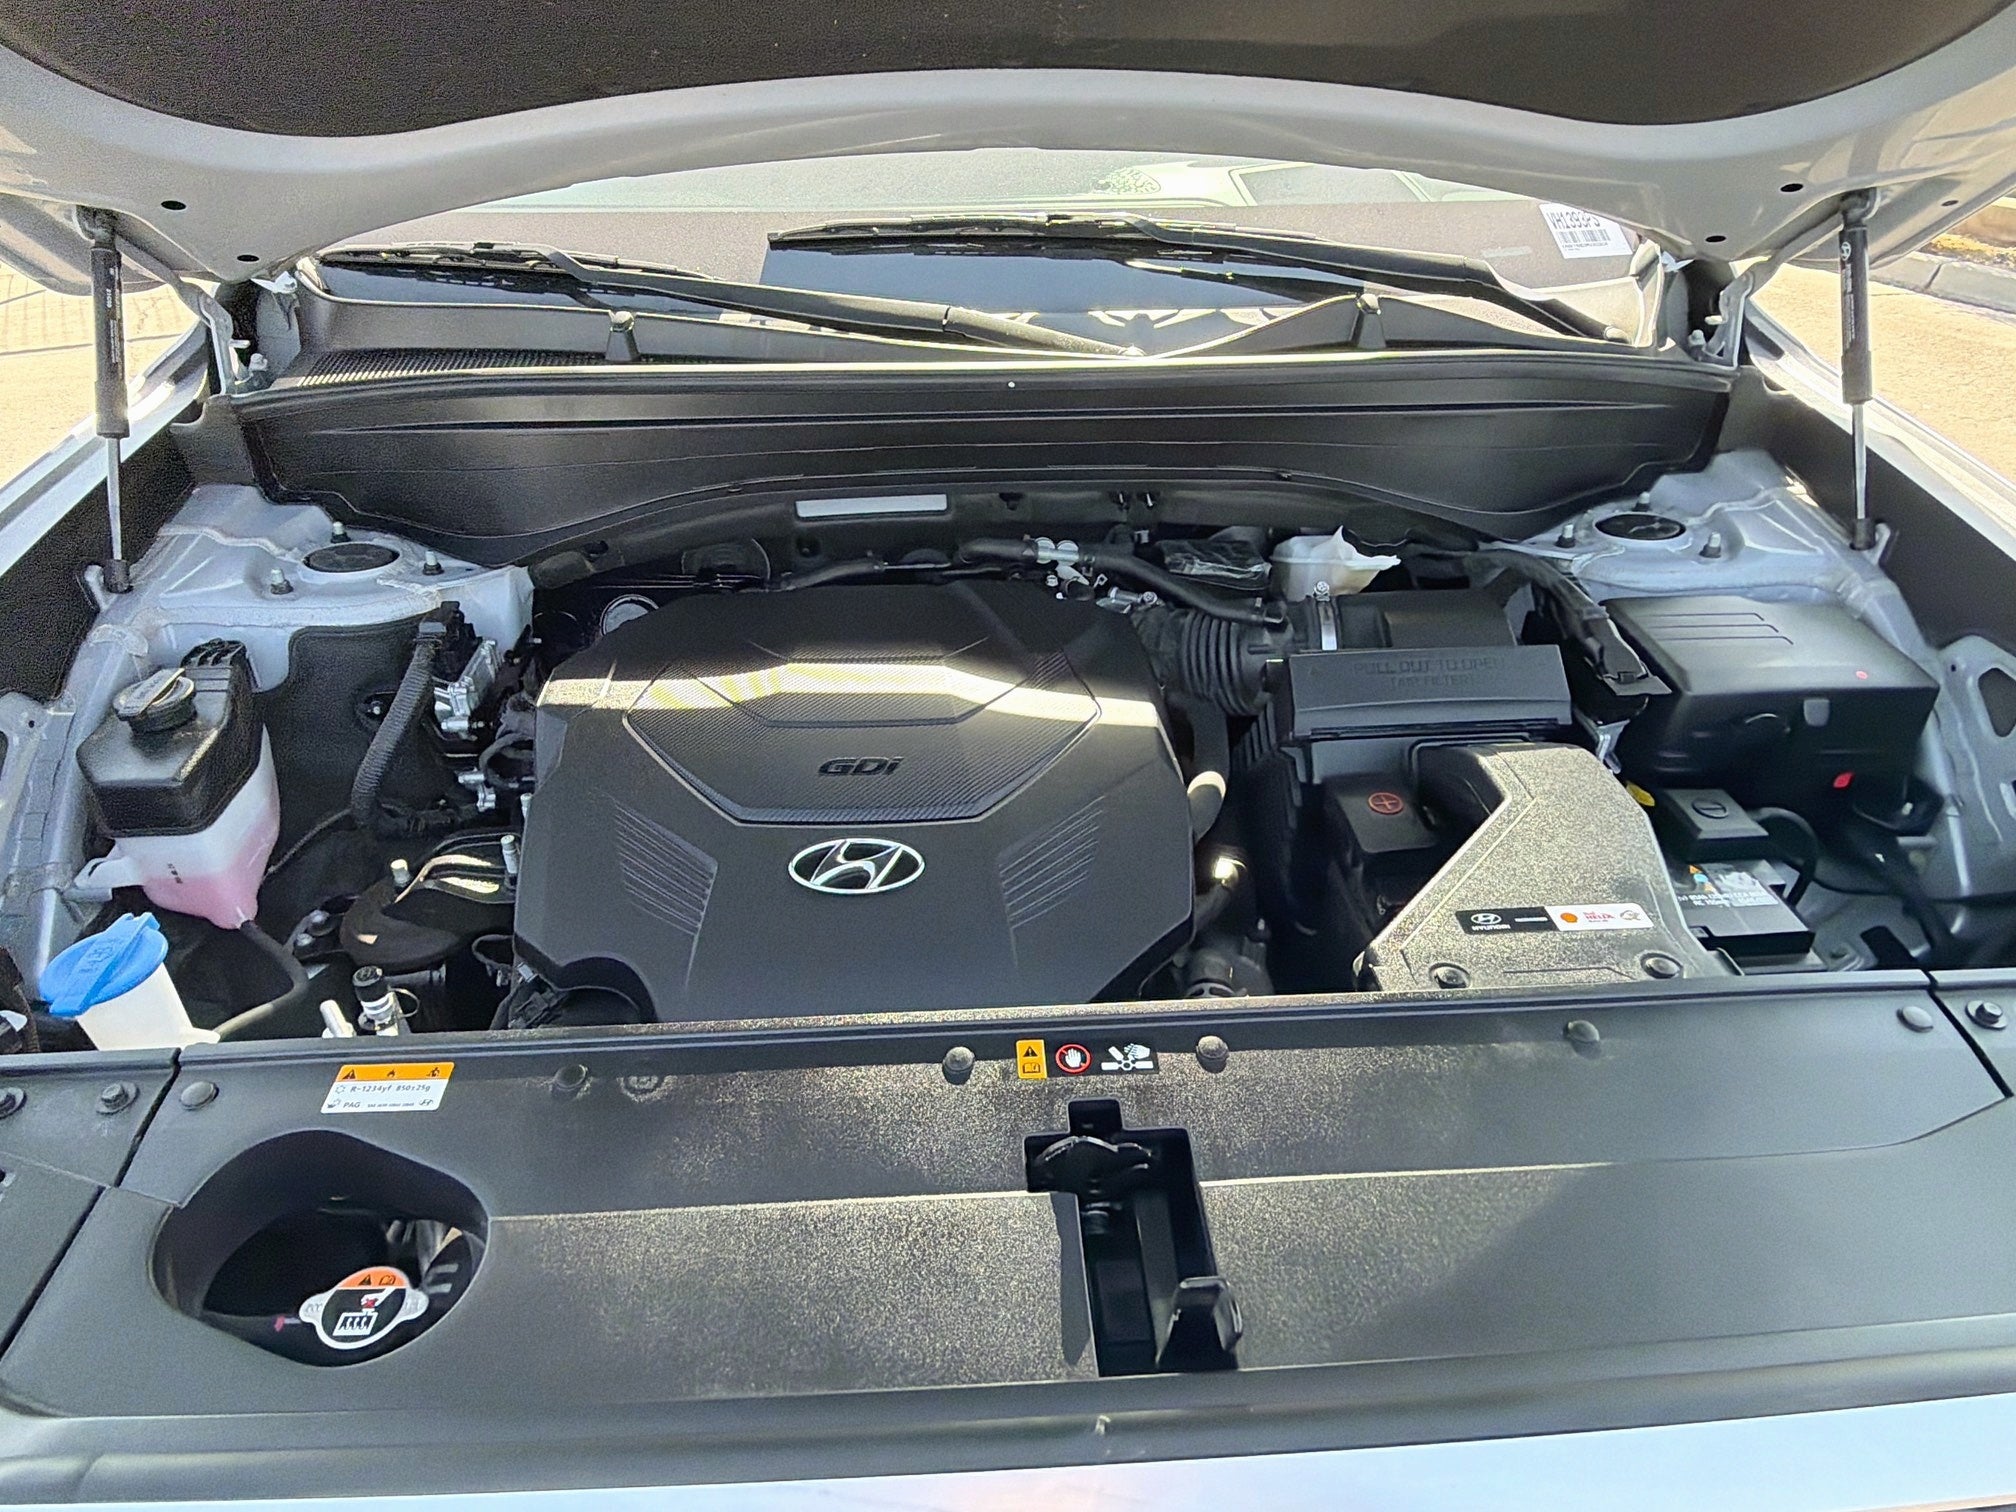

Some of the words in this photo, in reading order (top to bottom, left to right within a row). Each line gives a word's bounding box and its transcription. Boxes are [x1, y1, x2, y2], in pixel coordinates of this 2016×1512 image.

[1354, 661, 1396, 675] PULL
[1399, 659, 1430, 674] OUT
[1434, 658, 1458, 671] TO
[818, 756, 904, 775] GDi
[350, 1084, 392, 1093] R-1234yf
[343, 1101, 361, 1109] PAG
